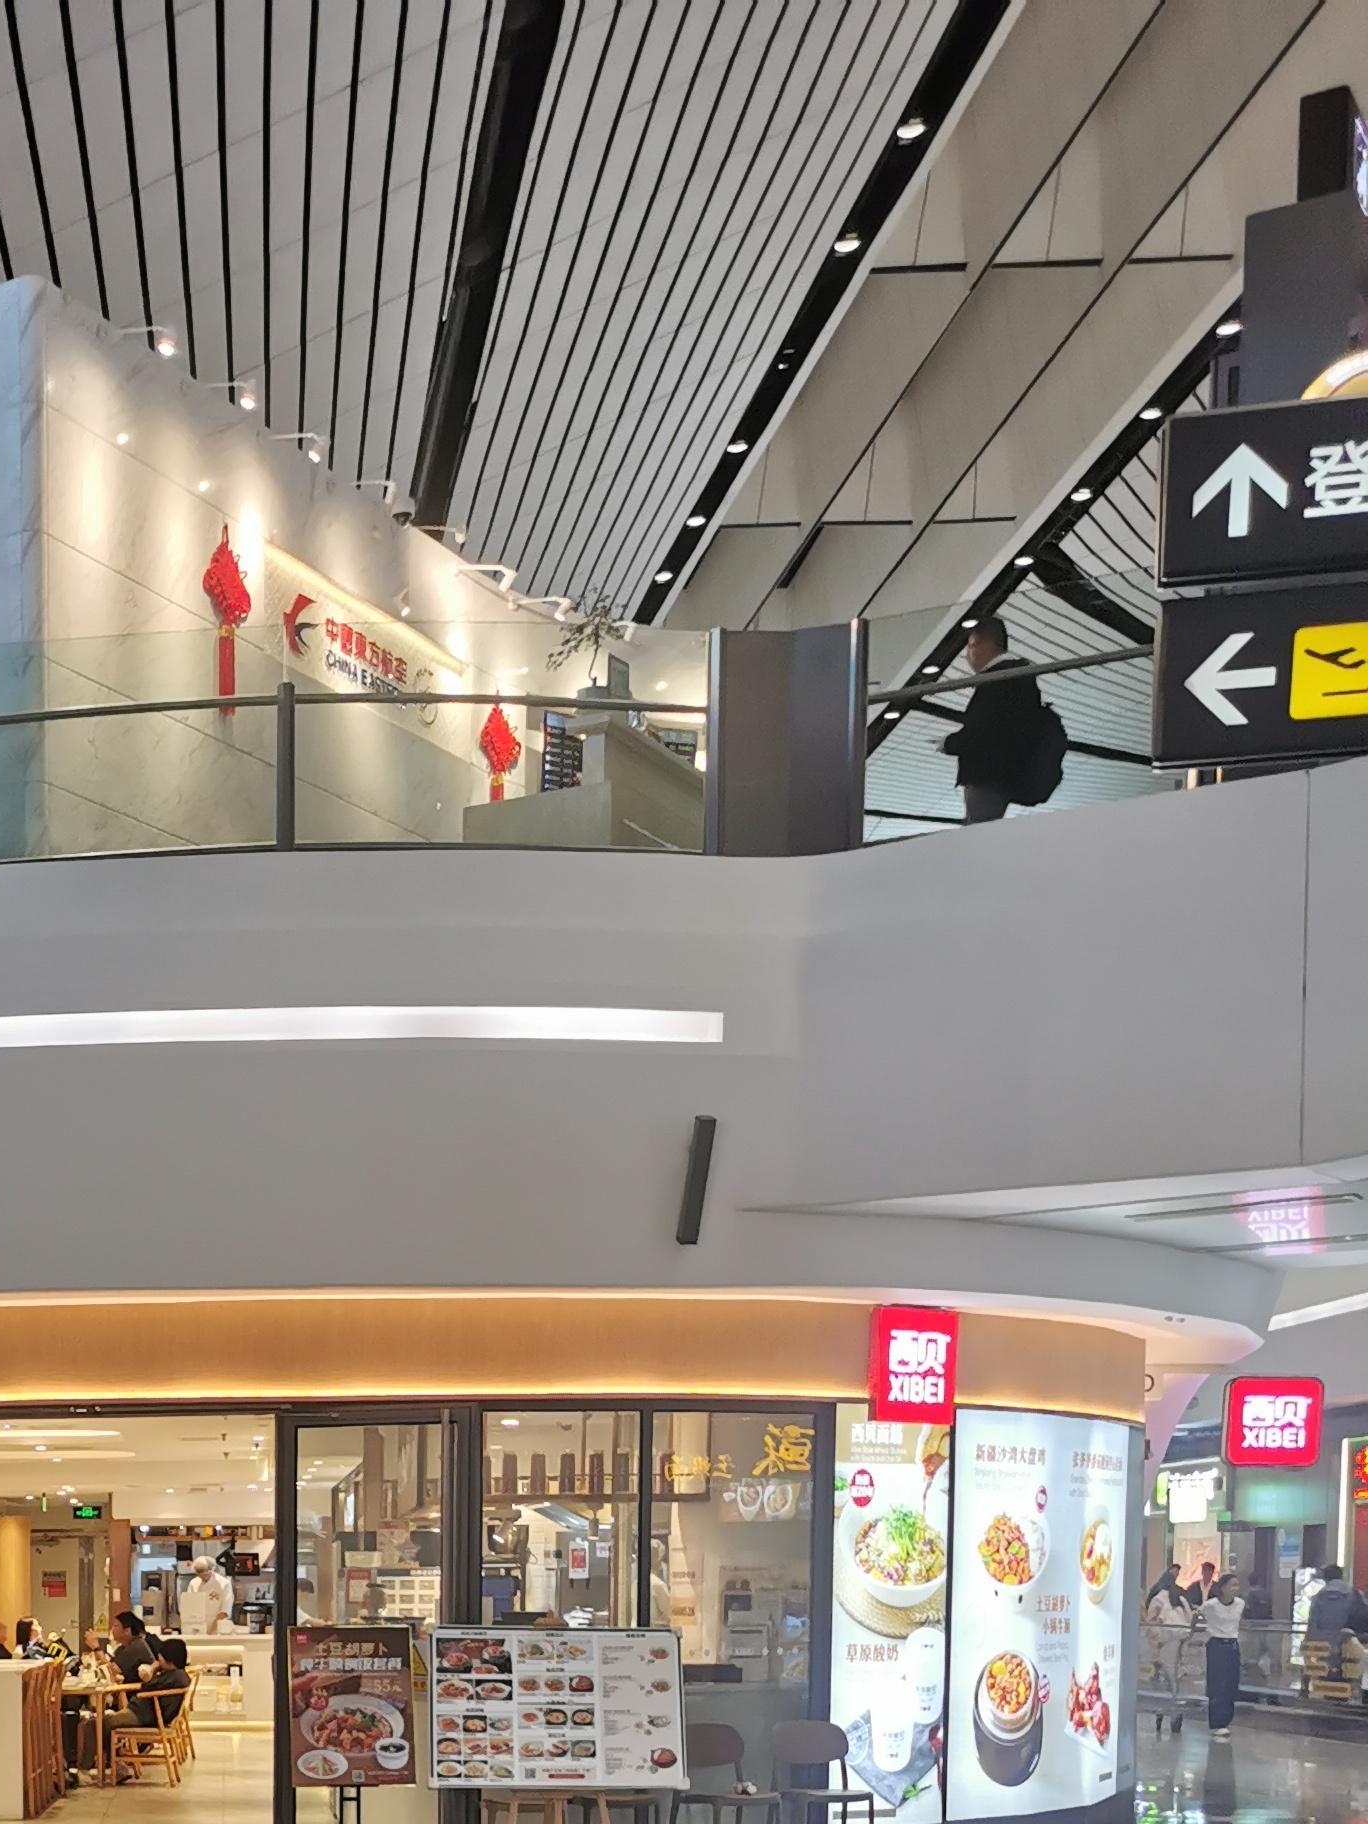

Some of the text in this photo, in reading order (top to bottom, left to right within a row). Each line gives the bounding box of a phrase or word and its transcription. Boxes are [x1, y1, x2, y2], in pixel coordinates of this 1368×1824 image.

[1303, 440, 1368, 518] 登
[326, 650, 358, 683] CHINA
[889, 1329, 952, 1374] 西贝
[888, 1374, 945, 1404] XIBEI
[1242, 1395, 1312, 1427] 西贝
[1241, 1427, 1306, 1449] XIBEI
[845, 1643, 899, 1663] 草原酸奶
